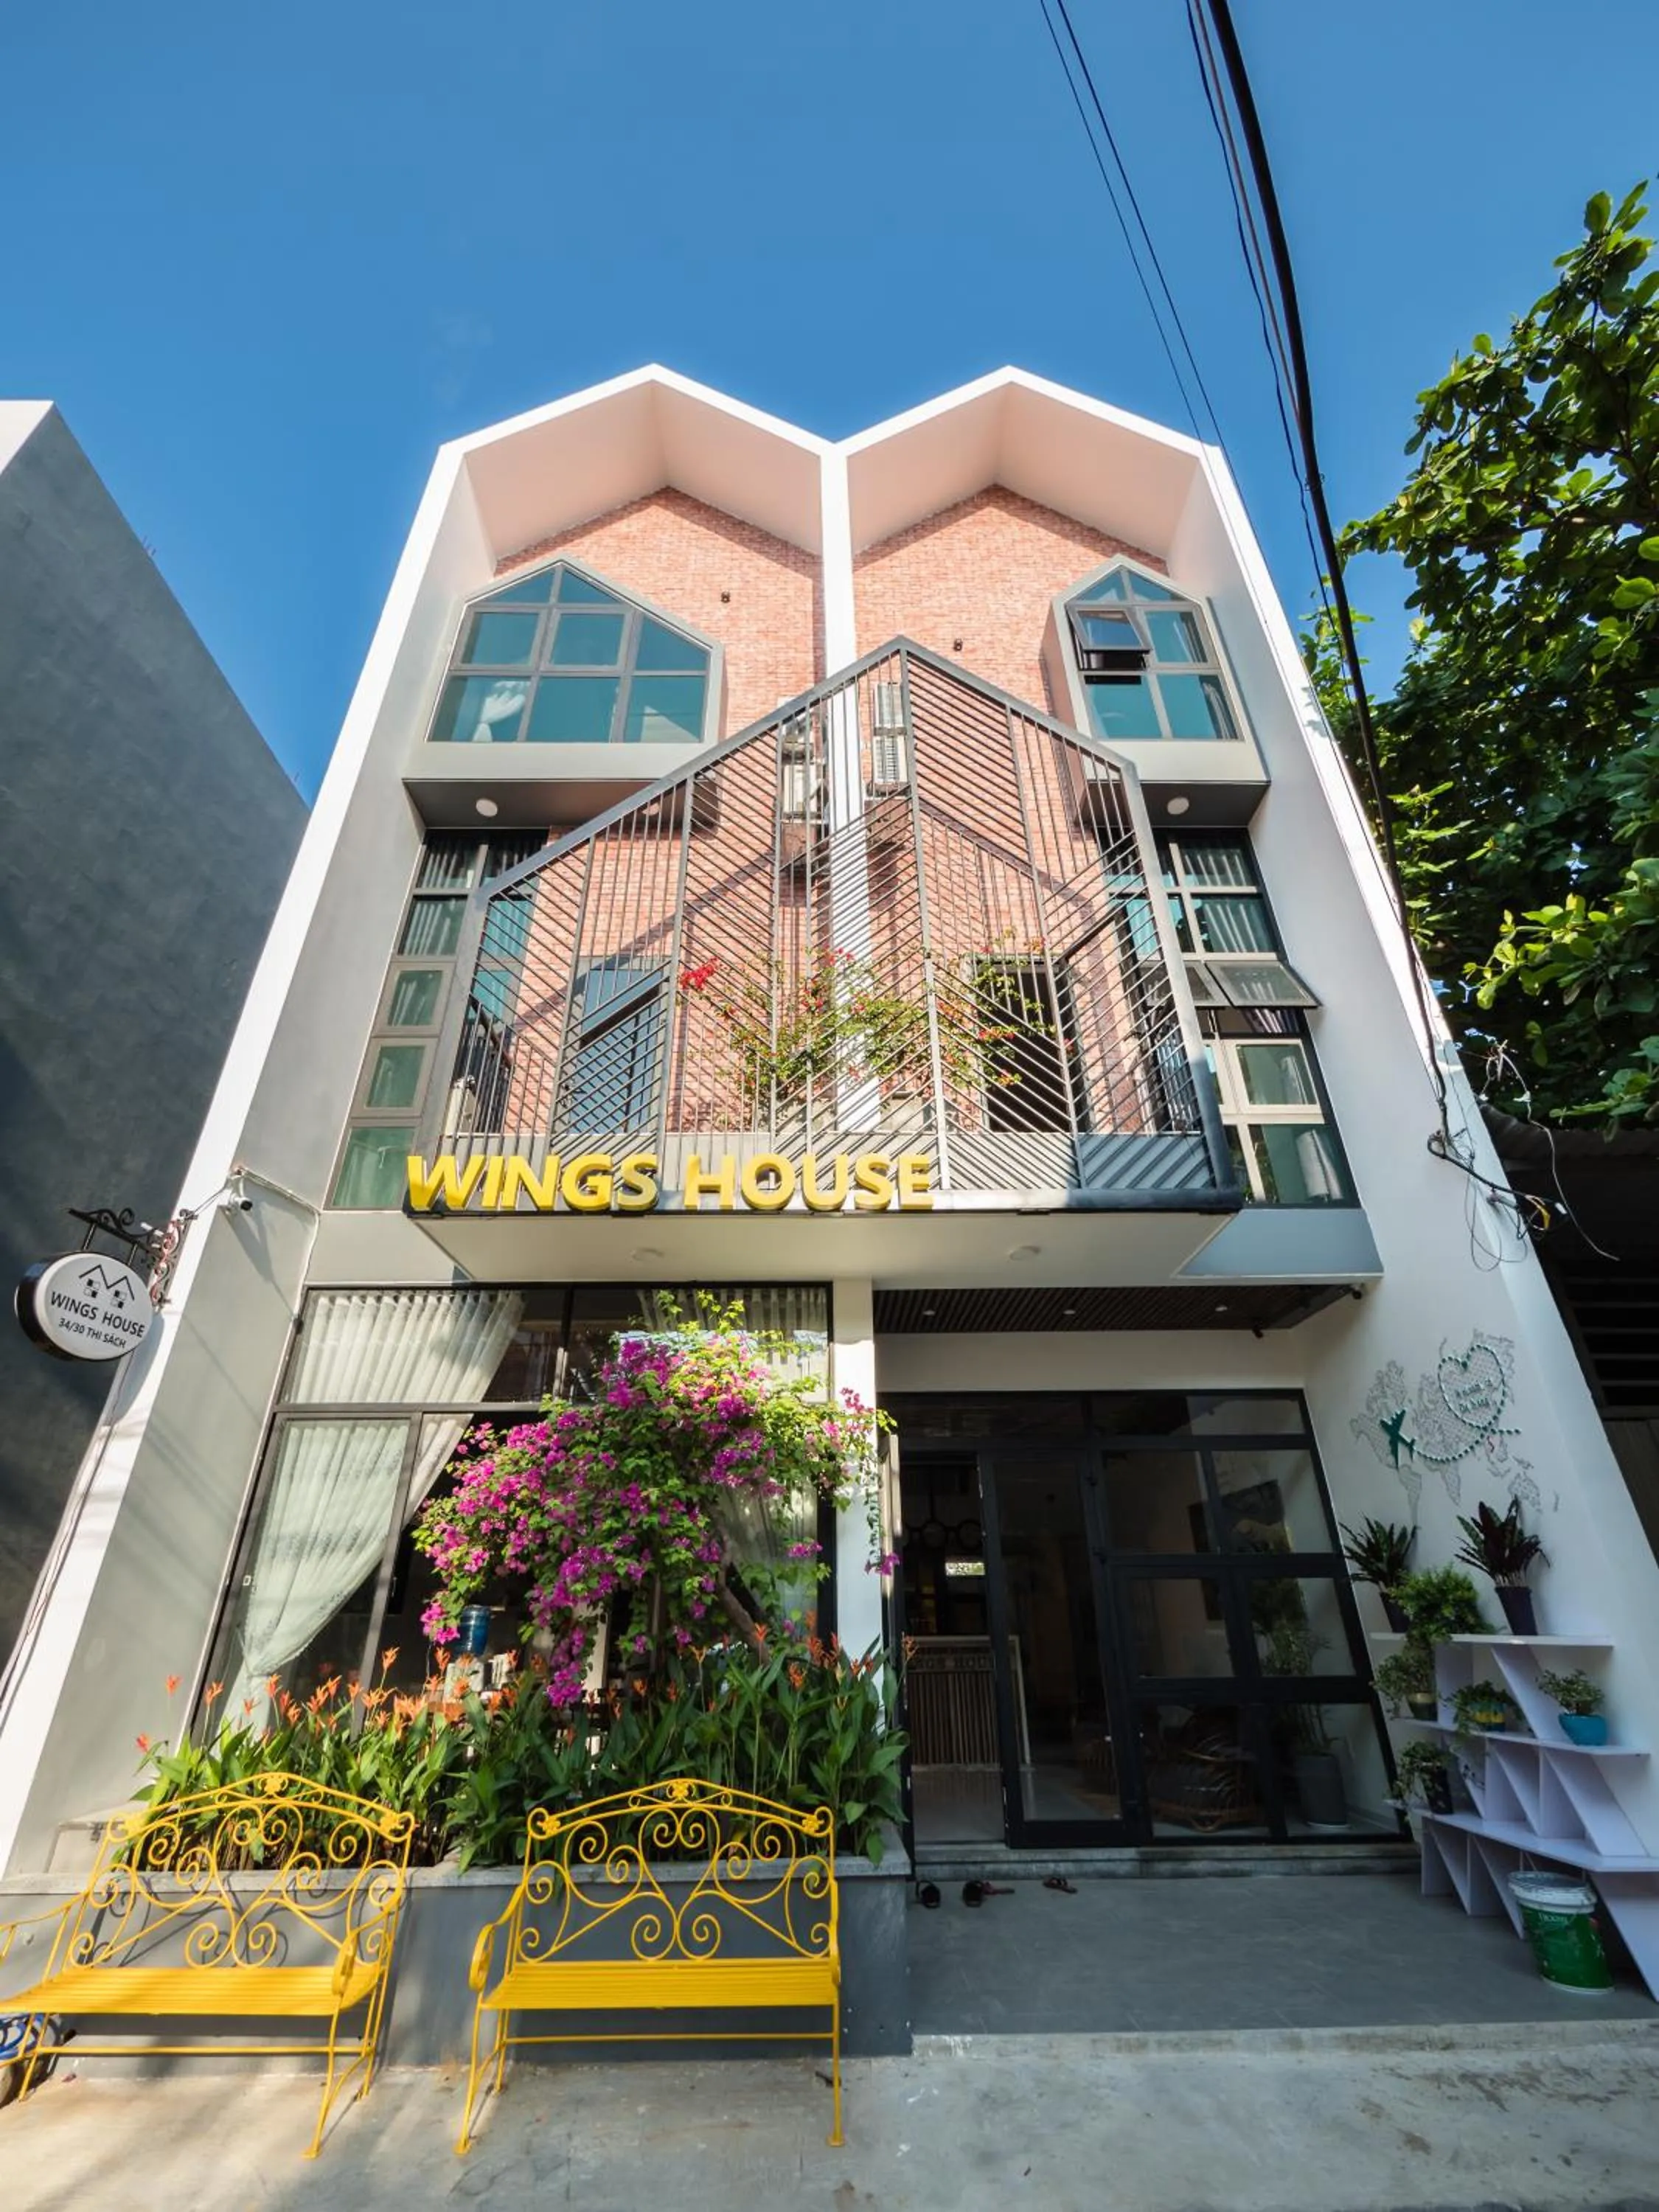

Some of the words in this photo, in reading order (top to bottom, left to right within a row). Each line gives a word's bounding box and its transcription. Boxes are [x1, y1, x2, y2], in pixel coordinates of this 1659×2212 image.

[407, 1153, 659, 1213] WINGS
[684, 1152, 933, 1212] HOUSE
[51, 1292, 98, 1320] WINGS
[102, 1311, 145, 1338] HOUSE
[58, 1318, 85, 1334] 34/30
[87, 1326, 102, 1340] THI
